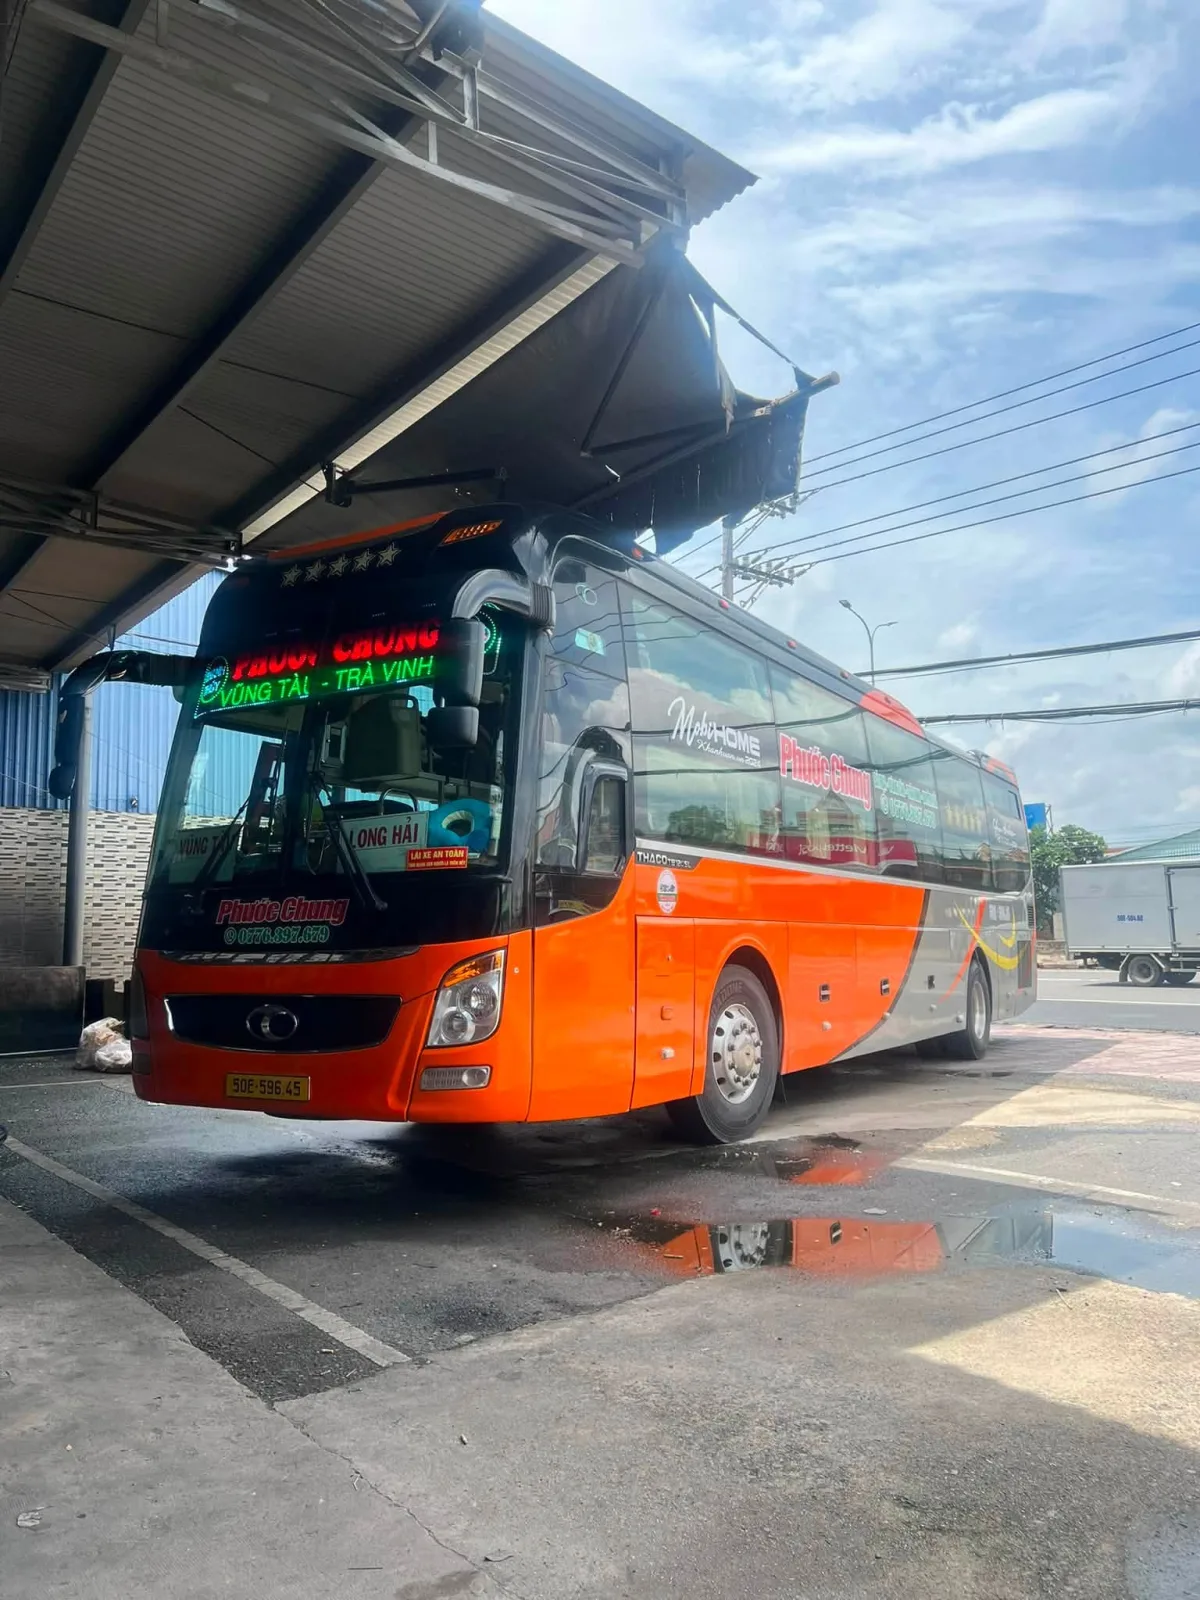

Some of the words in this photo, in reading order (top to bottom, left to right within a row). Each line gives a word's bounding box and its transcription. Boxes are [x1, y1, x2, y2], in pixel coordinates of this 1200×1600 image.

[220, 682, 271, 707] VŨNG
[335, 661, 374, 690] TRÀ
[382, 655, 434, 684] VINH
[779, 732, 830, 790] Phước
[830, 753, 872, 812] Chung
[349, 826, 387, 848] LONG
[392, 816, 419, 844] HẢI
[423, 850, 432, 859] XE
[433, 850, 443, 858] AN
[445, 848, 465, 858] TOÀN
[637, 851, 668, 865] THACO
[215, 897, 279, 925] Phước
[281, 895, 350, 927] Chung
[232, 1078, 301, 1097] 50E-596.45
